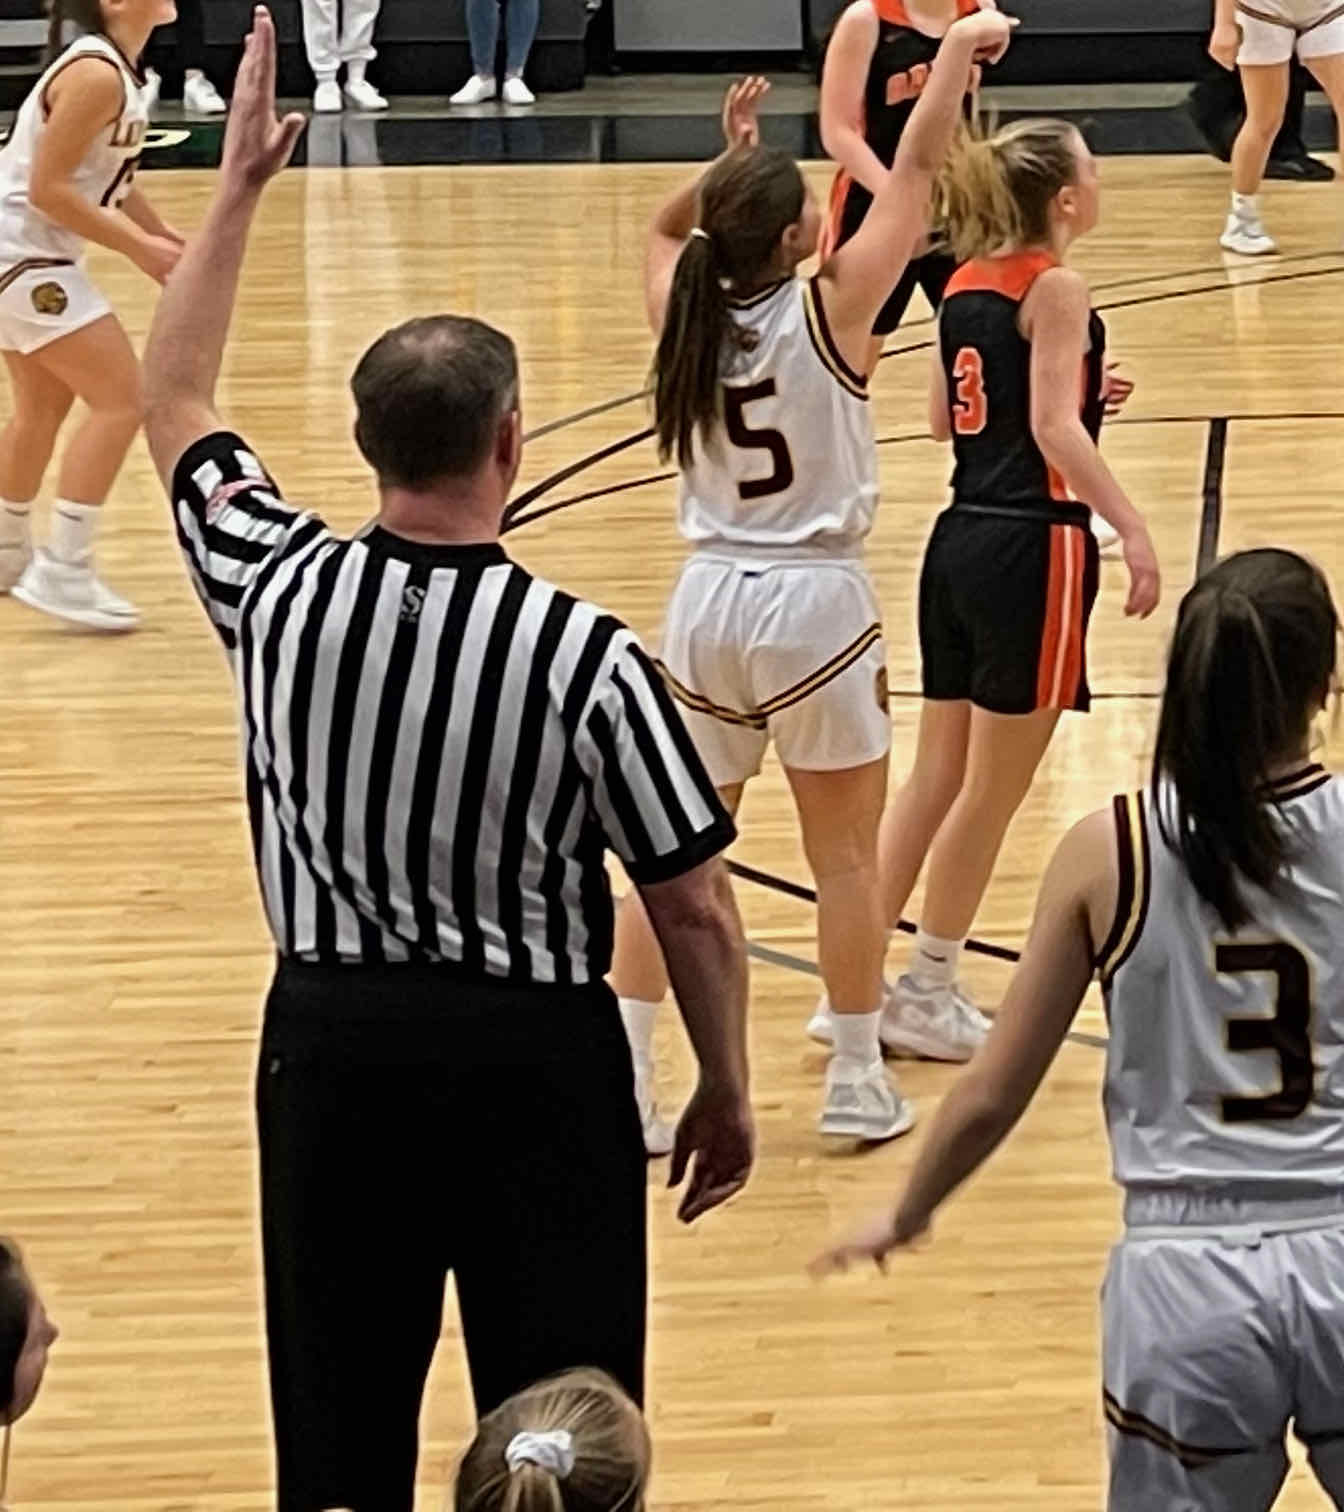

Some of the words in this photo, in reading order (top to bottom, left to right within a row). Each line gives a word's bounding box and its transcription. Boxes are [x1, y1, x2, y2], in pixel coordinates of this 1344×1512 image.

[722, 377, 795, 500] 5
[953, 346, 988, 435] 3
[1215, 941, 1315, 1123] 3
